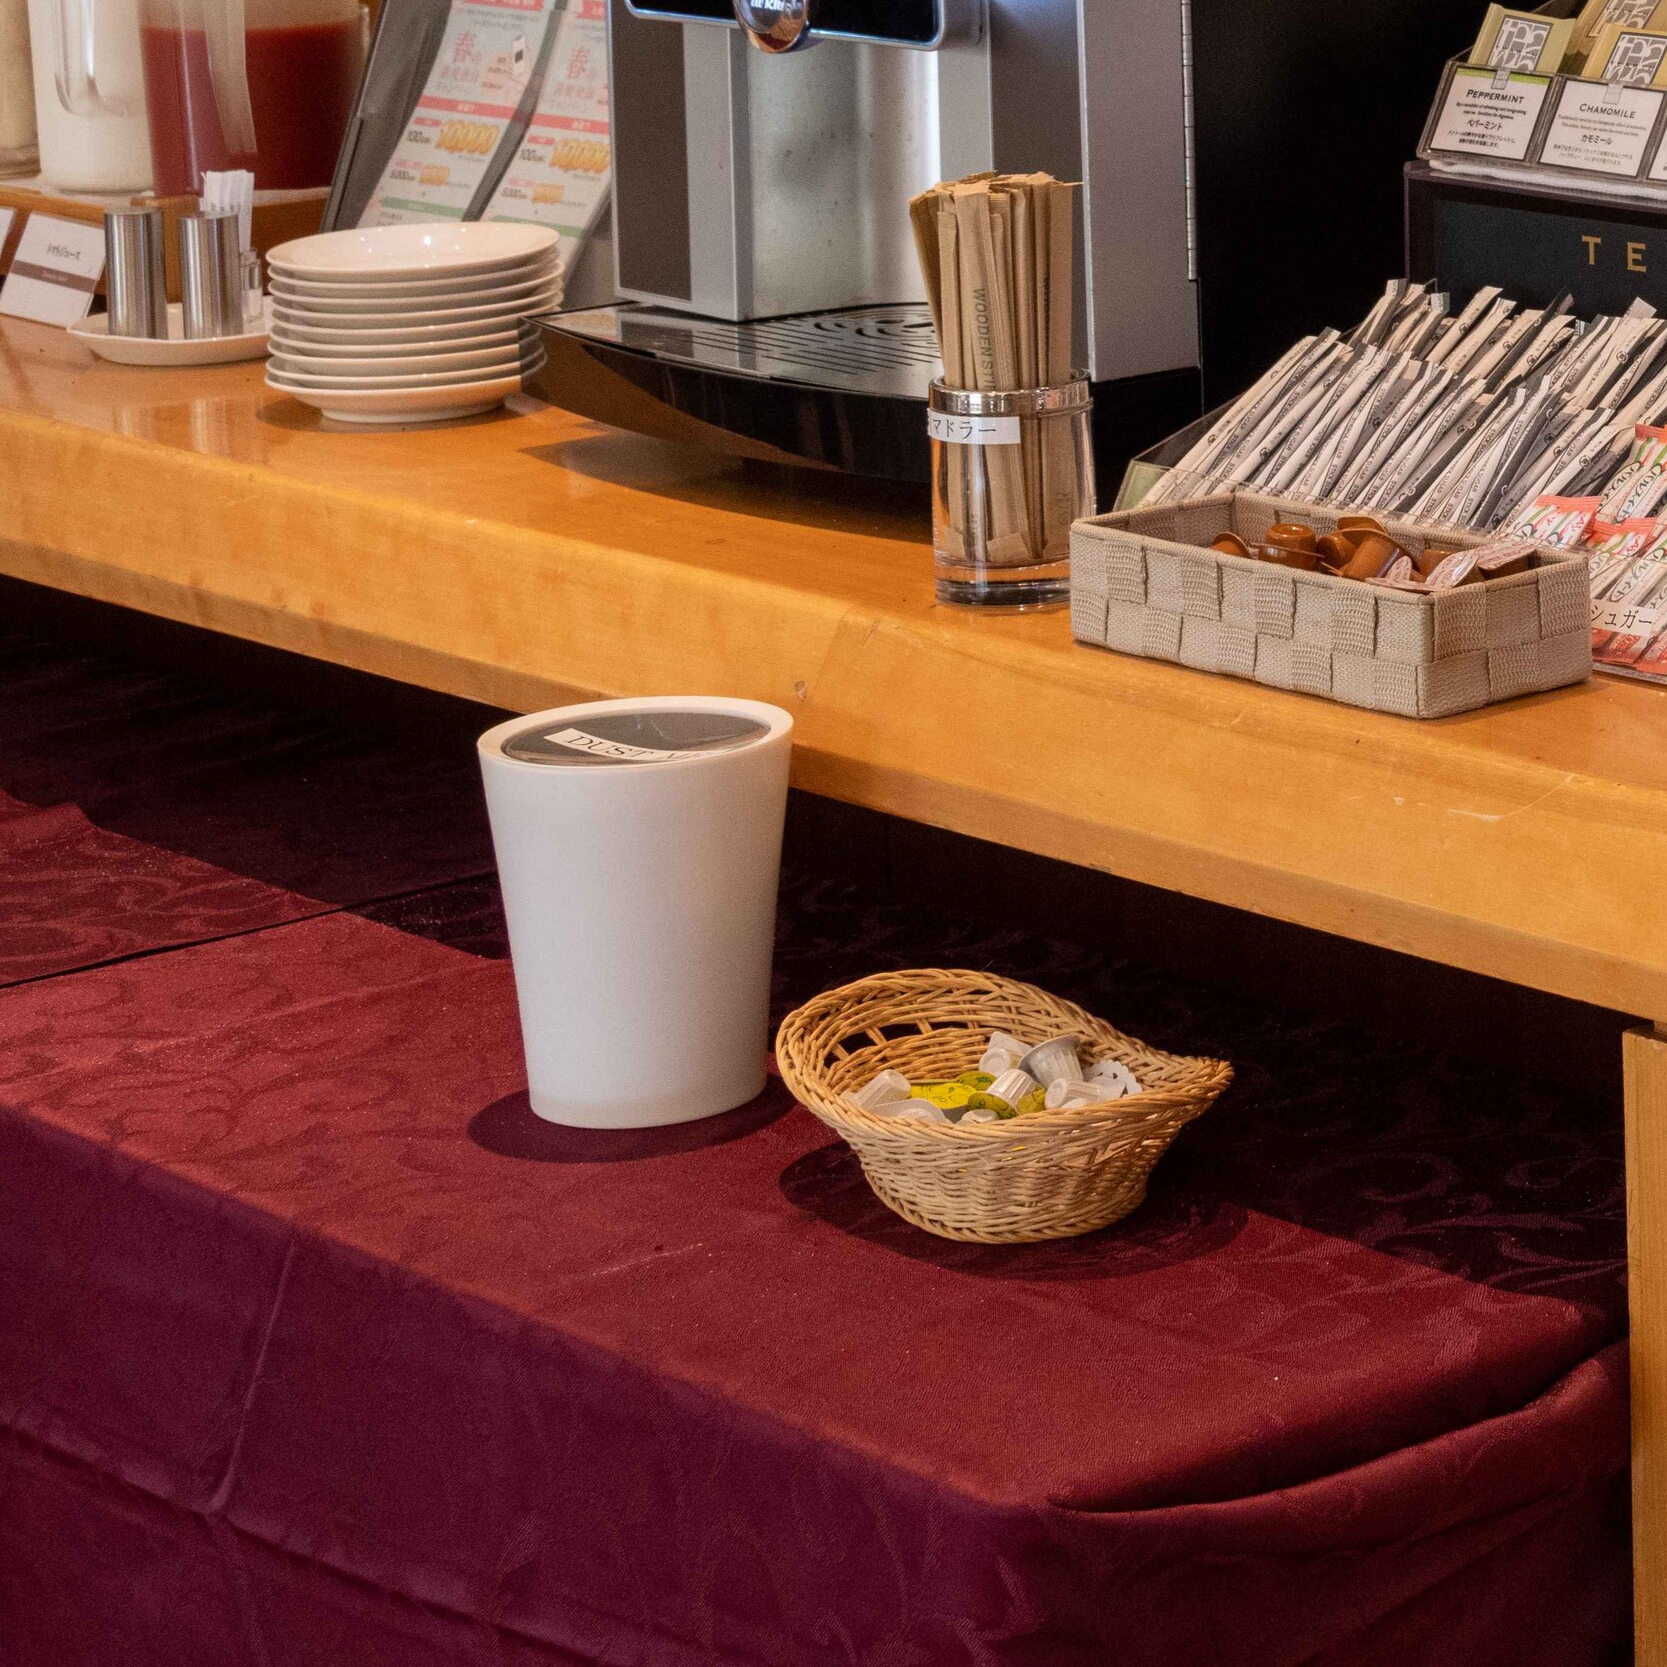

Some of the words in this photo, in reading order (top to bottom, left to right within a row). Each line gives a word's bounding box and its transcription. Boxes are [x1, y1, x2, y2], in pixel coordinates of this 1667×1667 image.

[1466, 89, 1525, 104] PEPPERMINT
[1579, 103, 1637, 119] CHAMOMILE
[1580, 134, 1614, 145] カモミール
[932, 418, 997, 440] マドラー
[1619, 468, 1658, 516] パルスイート
[565, 735, 655, 759] DUST
